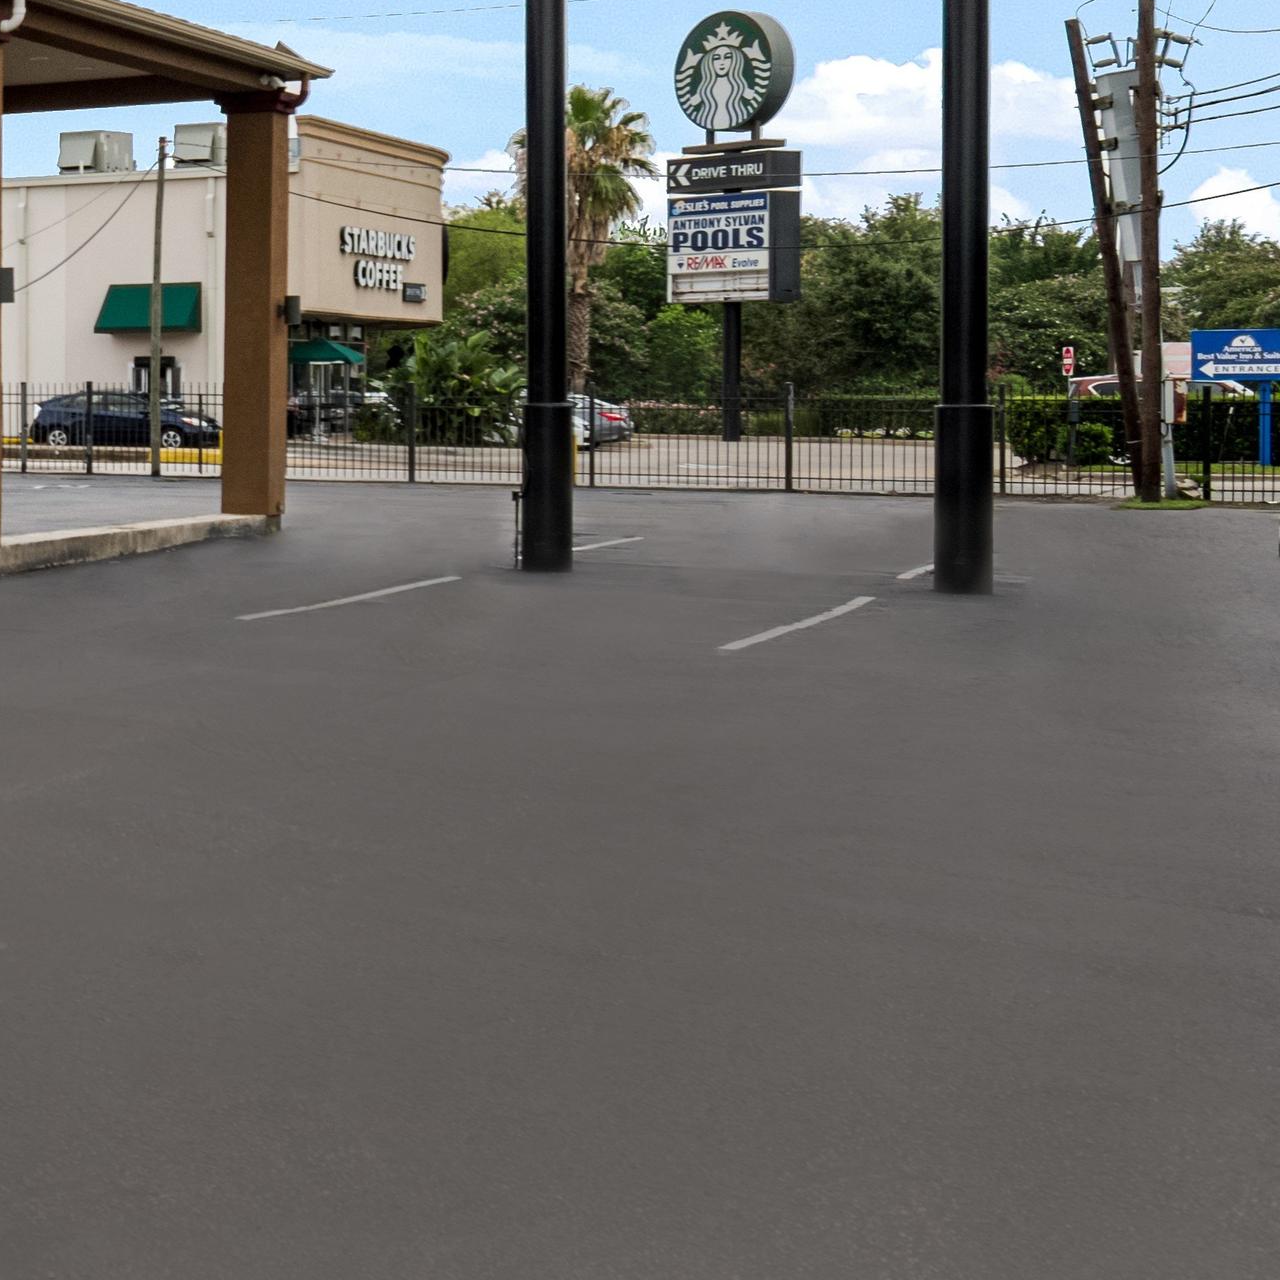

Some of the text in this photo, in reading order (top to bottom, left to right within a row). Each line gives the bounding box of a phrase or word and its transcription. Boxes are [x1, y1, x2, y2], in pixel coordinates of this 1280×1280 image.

[691, 163, 764, 180] DRIVE THRU
[730, 199, 765, 209] SUPPLIES
[672, 214, 765, 231] ANTHONY SYLVAN
[341, 226, 416, 261] STARBUCKS
[672, 226, 765, 253] POOLS
[686, 255, 760, 271] RE/MAX Evolve
[355, 260, 404, 290] COFFEE
[1197, 352, 1215, 360] Best
[1216, 352, 1238, 360] Value
[1239, 352, 1253, 360] Inn
[1215, 365, 1280, 373] ENTRANCE
